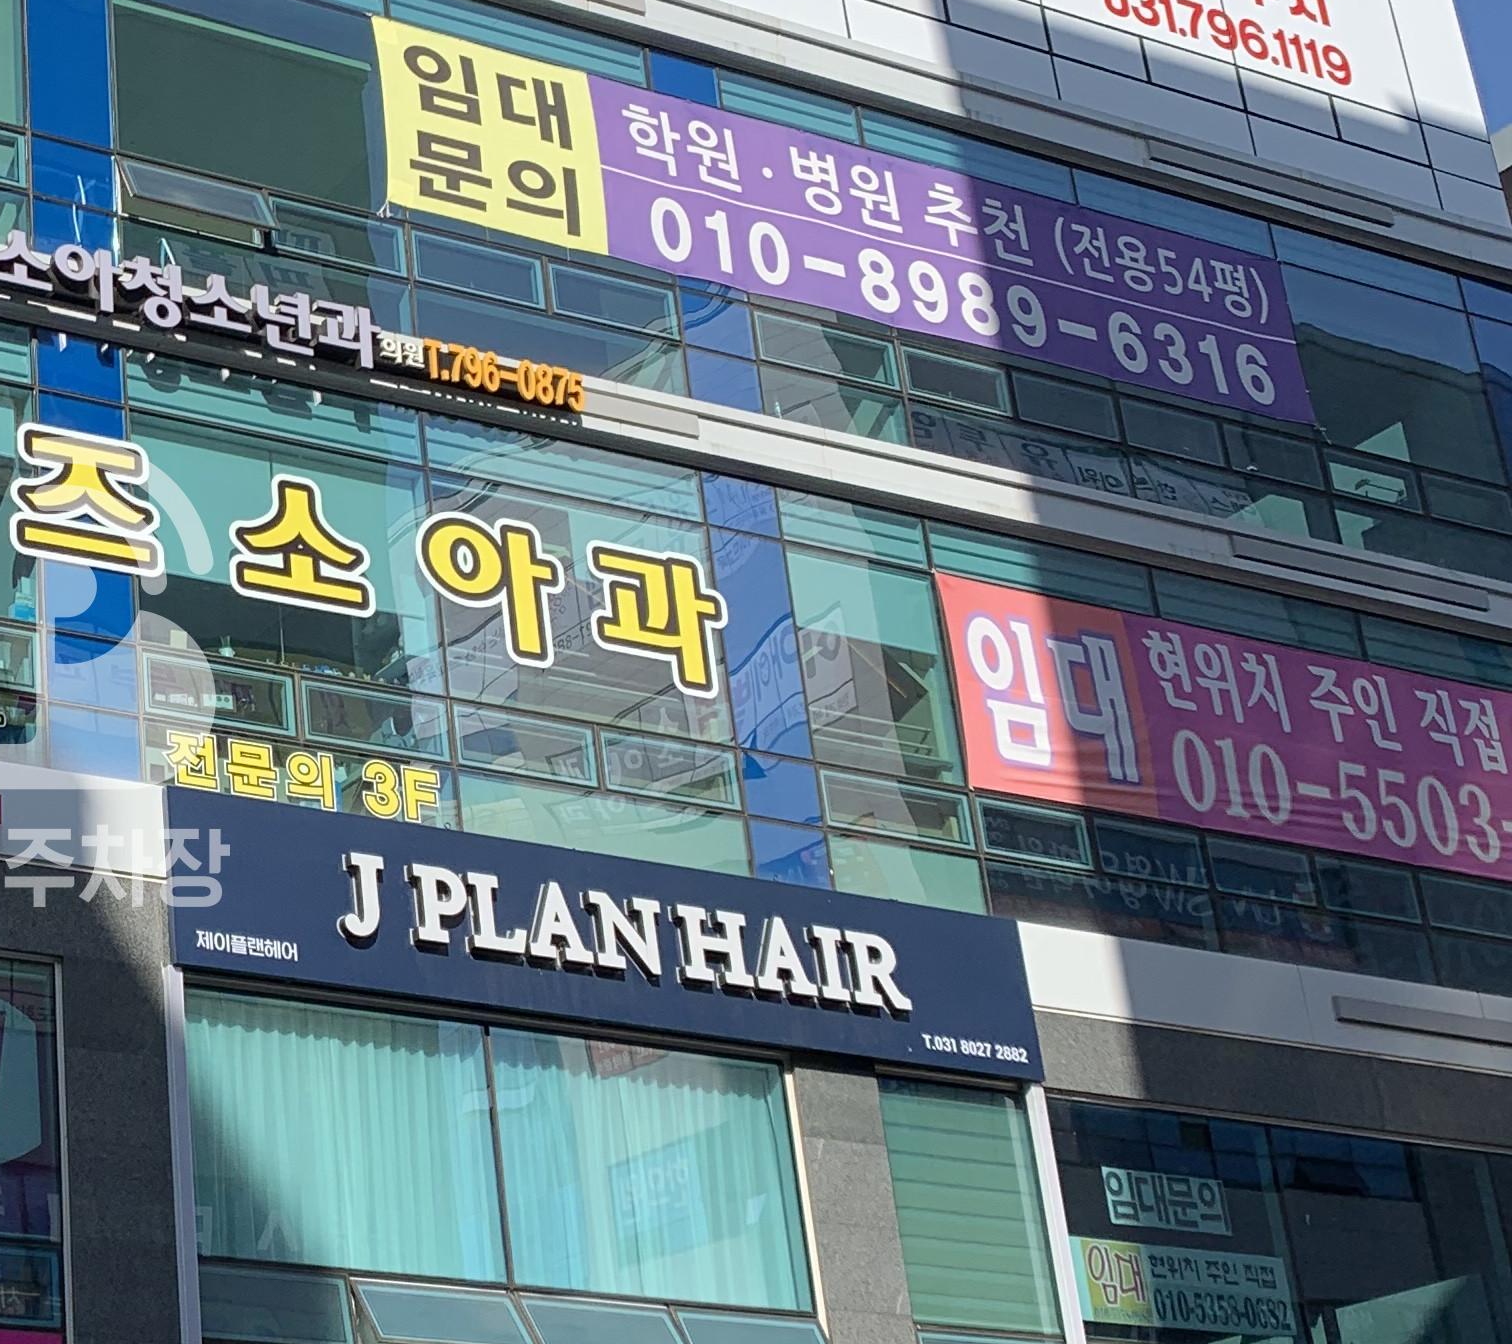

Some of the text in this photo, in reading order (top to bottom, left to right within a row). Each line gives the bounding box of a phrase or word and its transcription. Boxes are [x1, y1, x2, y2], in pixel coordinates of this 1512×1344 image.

[403, 44, 572, 151] 임대
[409, 132, 581, 236] 문의
[924, 182, 1033, 269] 추천
[1054, 203, 1269, 325] (전용54평)
[650, 197, 1276, 406] 010-8989-6316
[424, 337, 587, 413] T.796-0875
[965, 615, 1511, 785] 임대 현위치 주인 직접
[164, 729, 442, 824] 전문의 3F
[338, 851, 385, 941] J
[196, 929, 300, 963] 제이플랜헤어
[960, 1036, 994, 1058] 8027
[995, 1040, 1030, 1064] 2882
[1105, 1170, 1230, 1233] 임대문의
[1087, 1243, 1278, 1306] 임대 현위치 주인 직접
